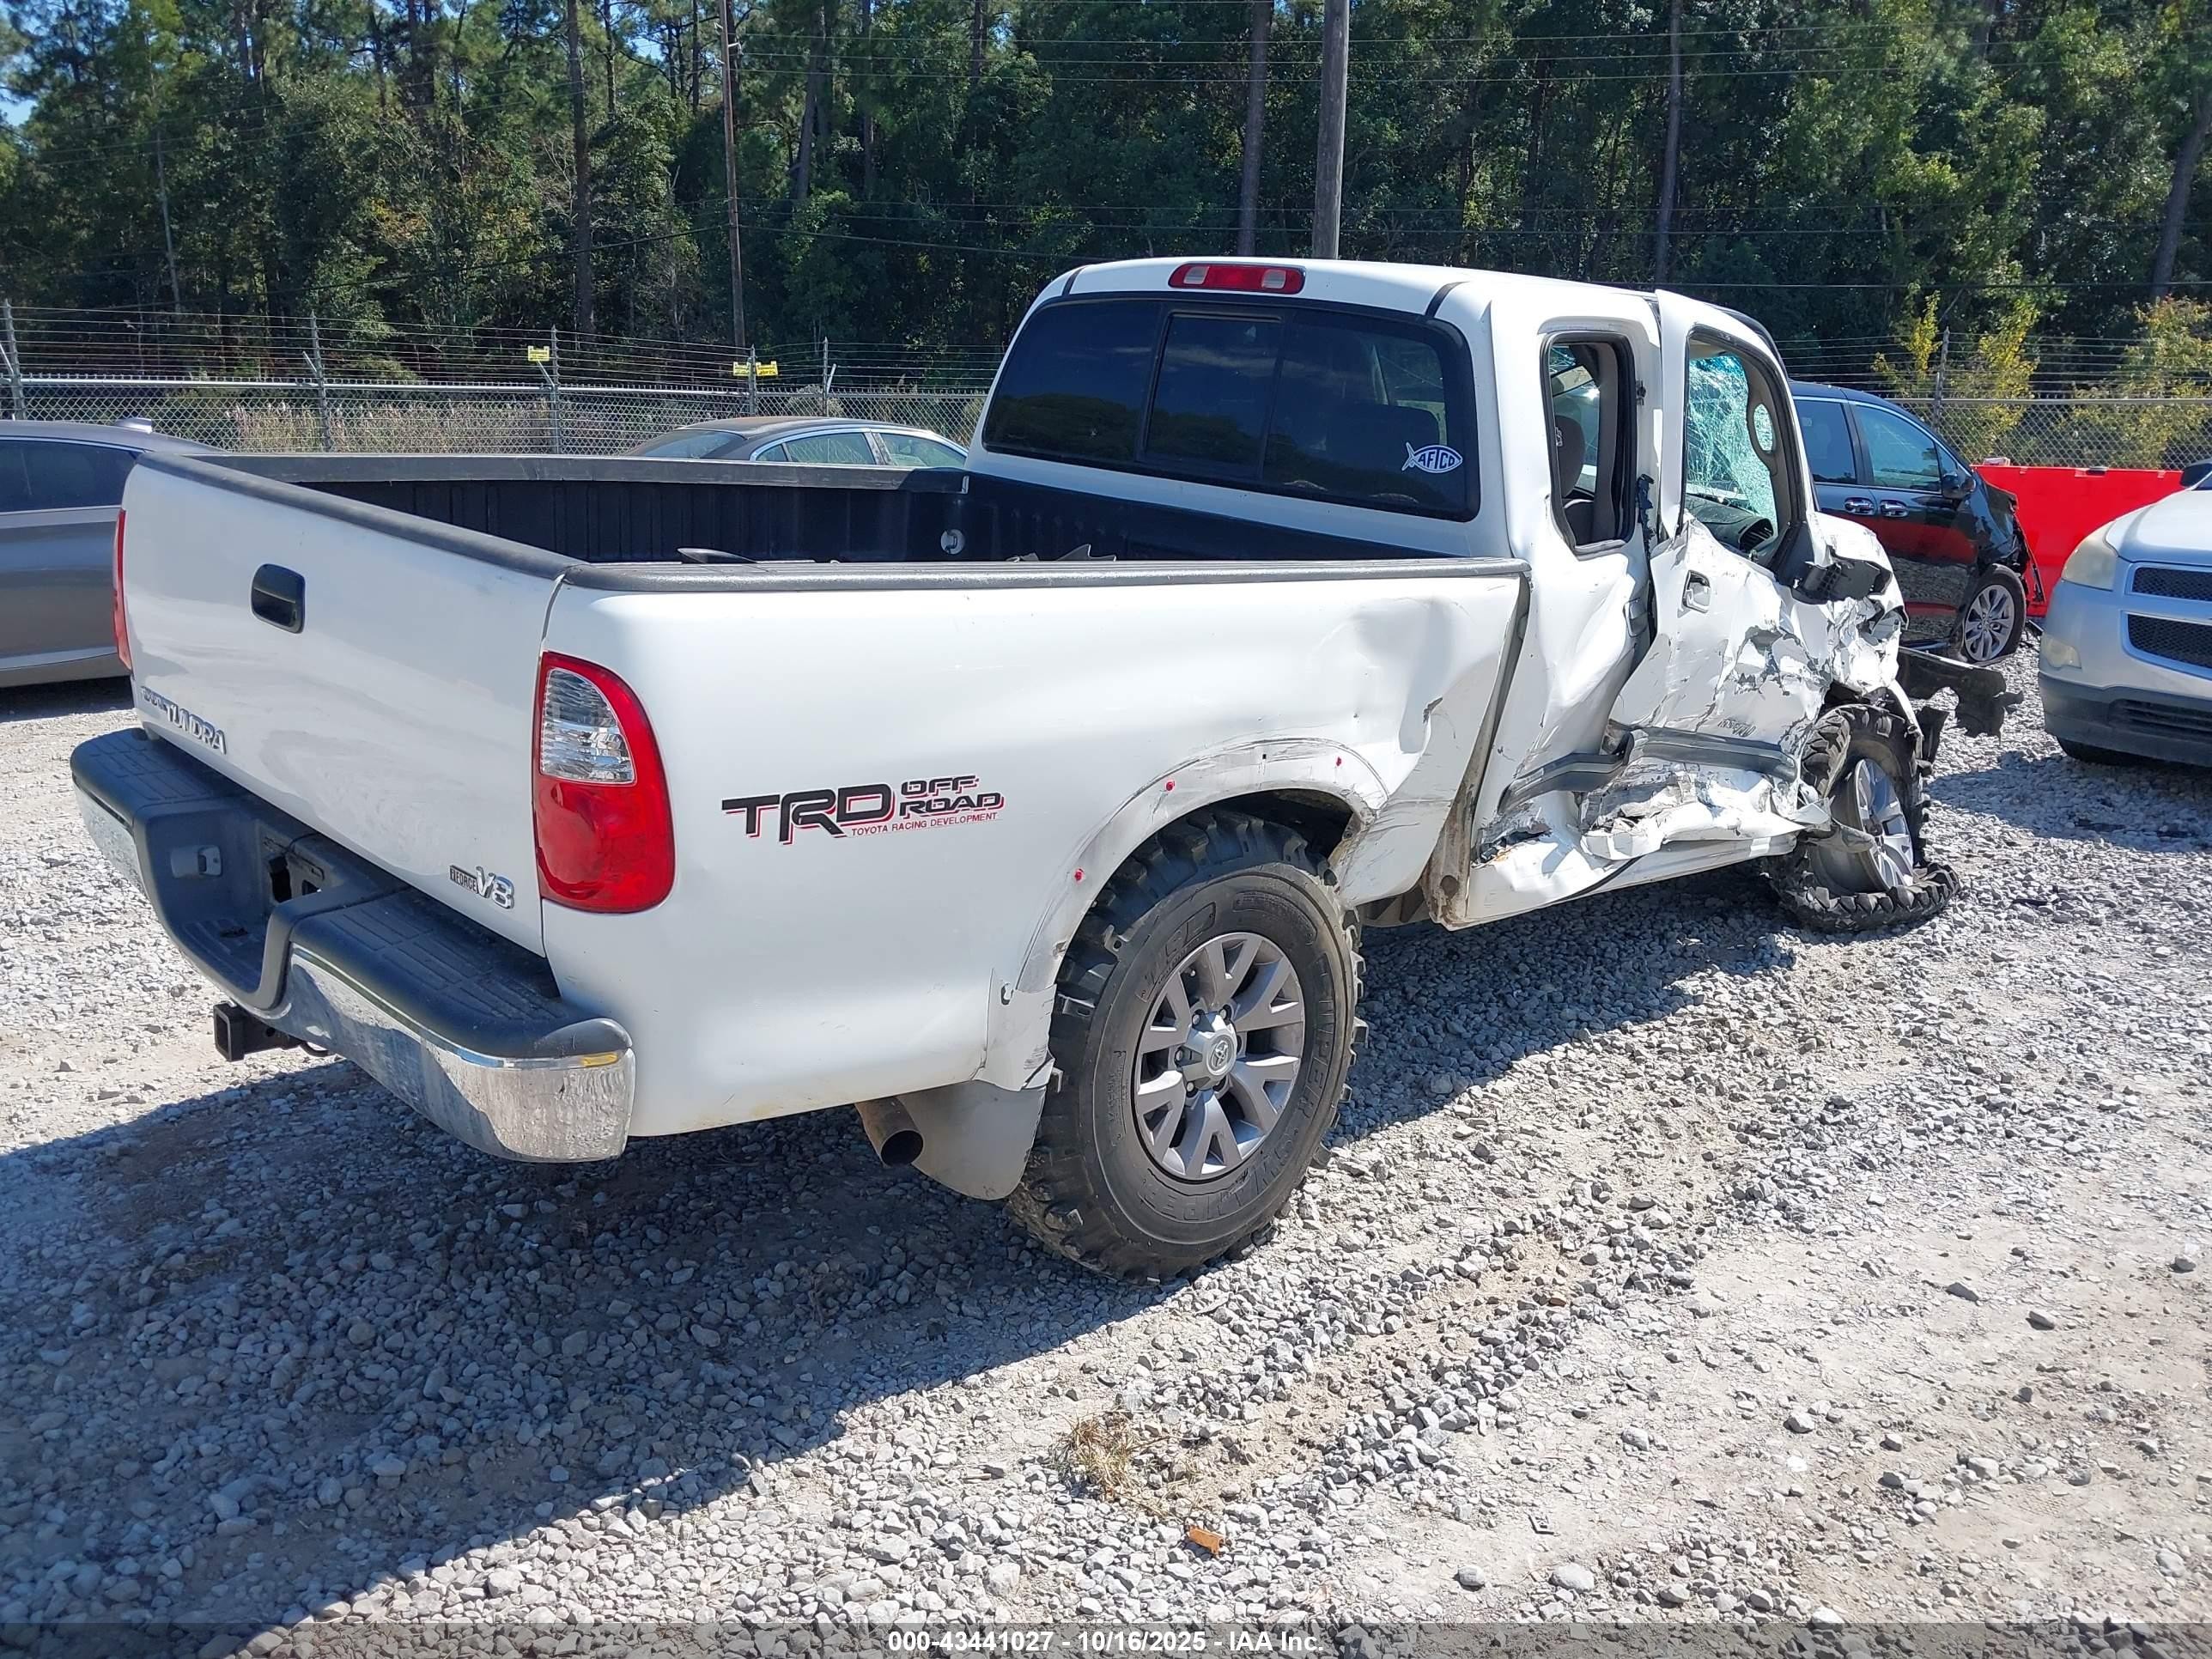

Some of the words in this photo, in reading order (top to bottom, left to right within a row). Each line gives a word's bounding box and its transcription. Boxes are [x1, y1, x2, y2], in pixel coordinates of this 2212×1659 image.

[165, 700, 227, 755] TUNDRA
[901, 775, 980, 798] OFF
[721, 783, 896, 846] TRD
[899, 792, 1005, 819] ROAD
[851, 825, 889, 836] TOYOTA
[891, 821, 927, 832] RACING
[930, 812, 998, 827] DEVELOPMENT
[475, 866, 515, 910] V8
